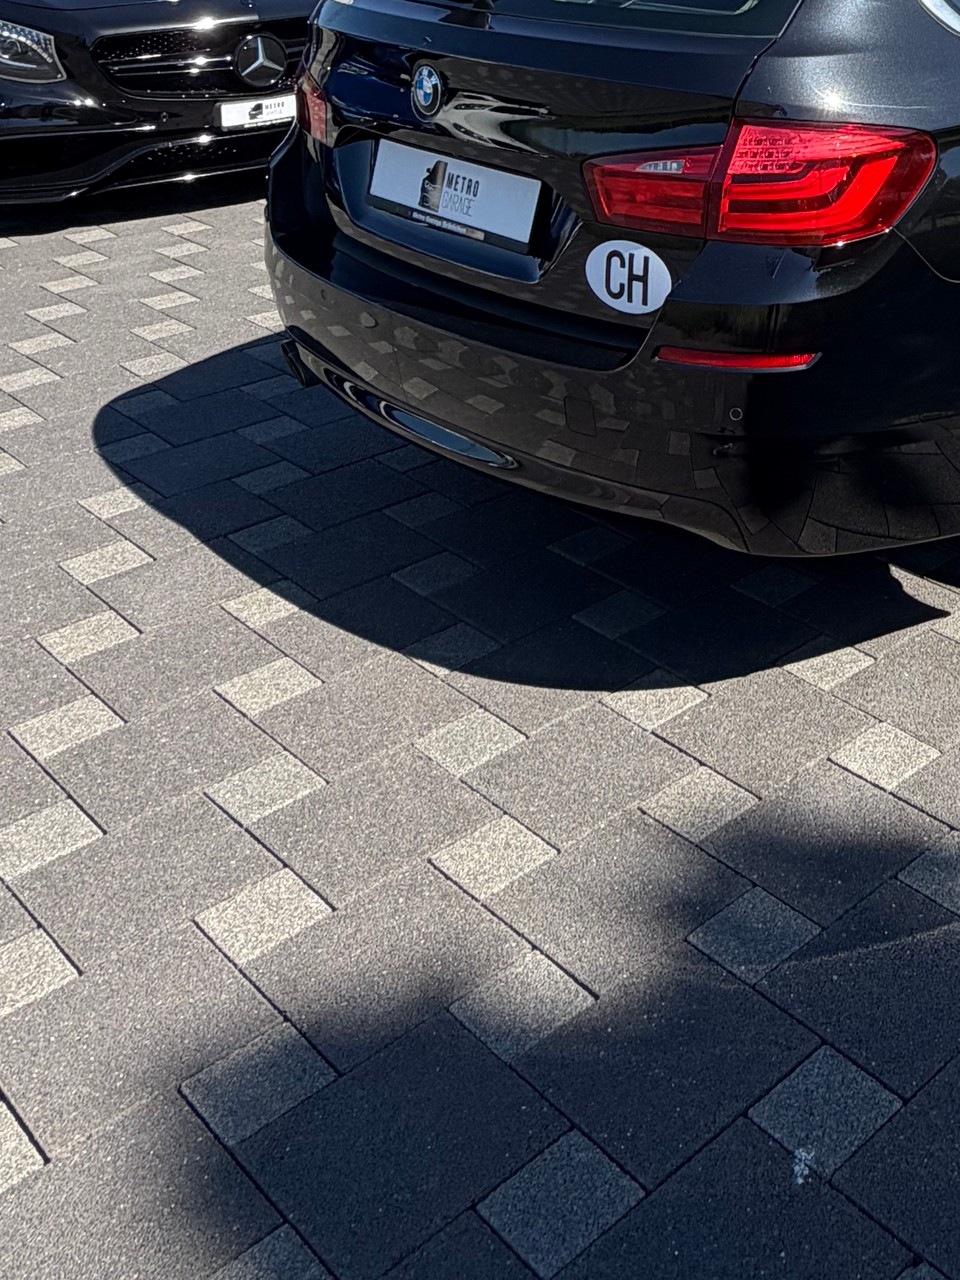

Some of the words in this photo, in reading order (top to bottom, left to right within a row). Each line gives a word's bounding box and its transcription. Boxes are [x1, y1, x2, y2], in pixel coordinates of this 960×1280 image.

[446, 171, 480, 198] METRO
[441, 191, 475, 217] GARAGE
[605, 249, 650, 306] CH
